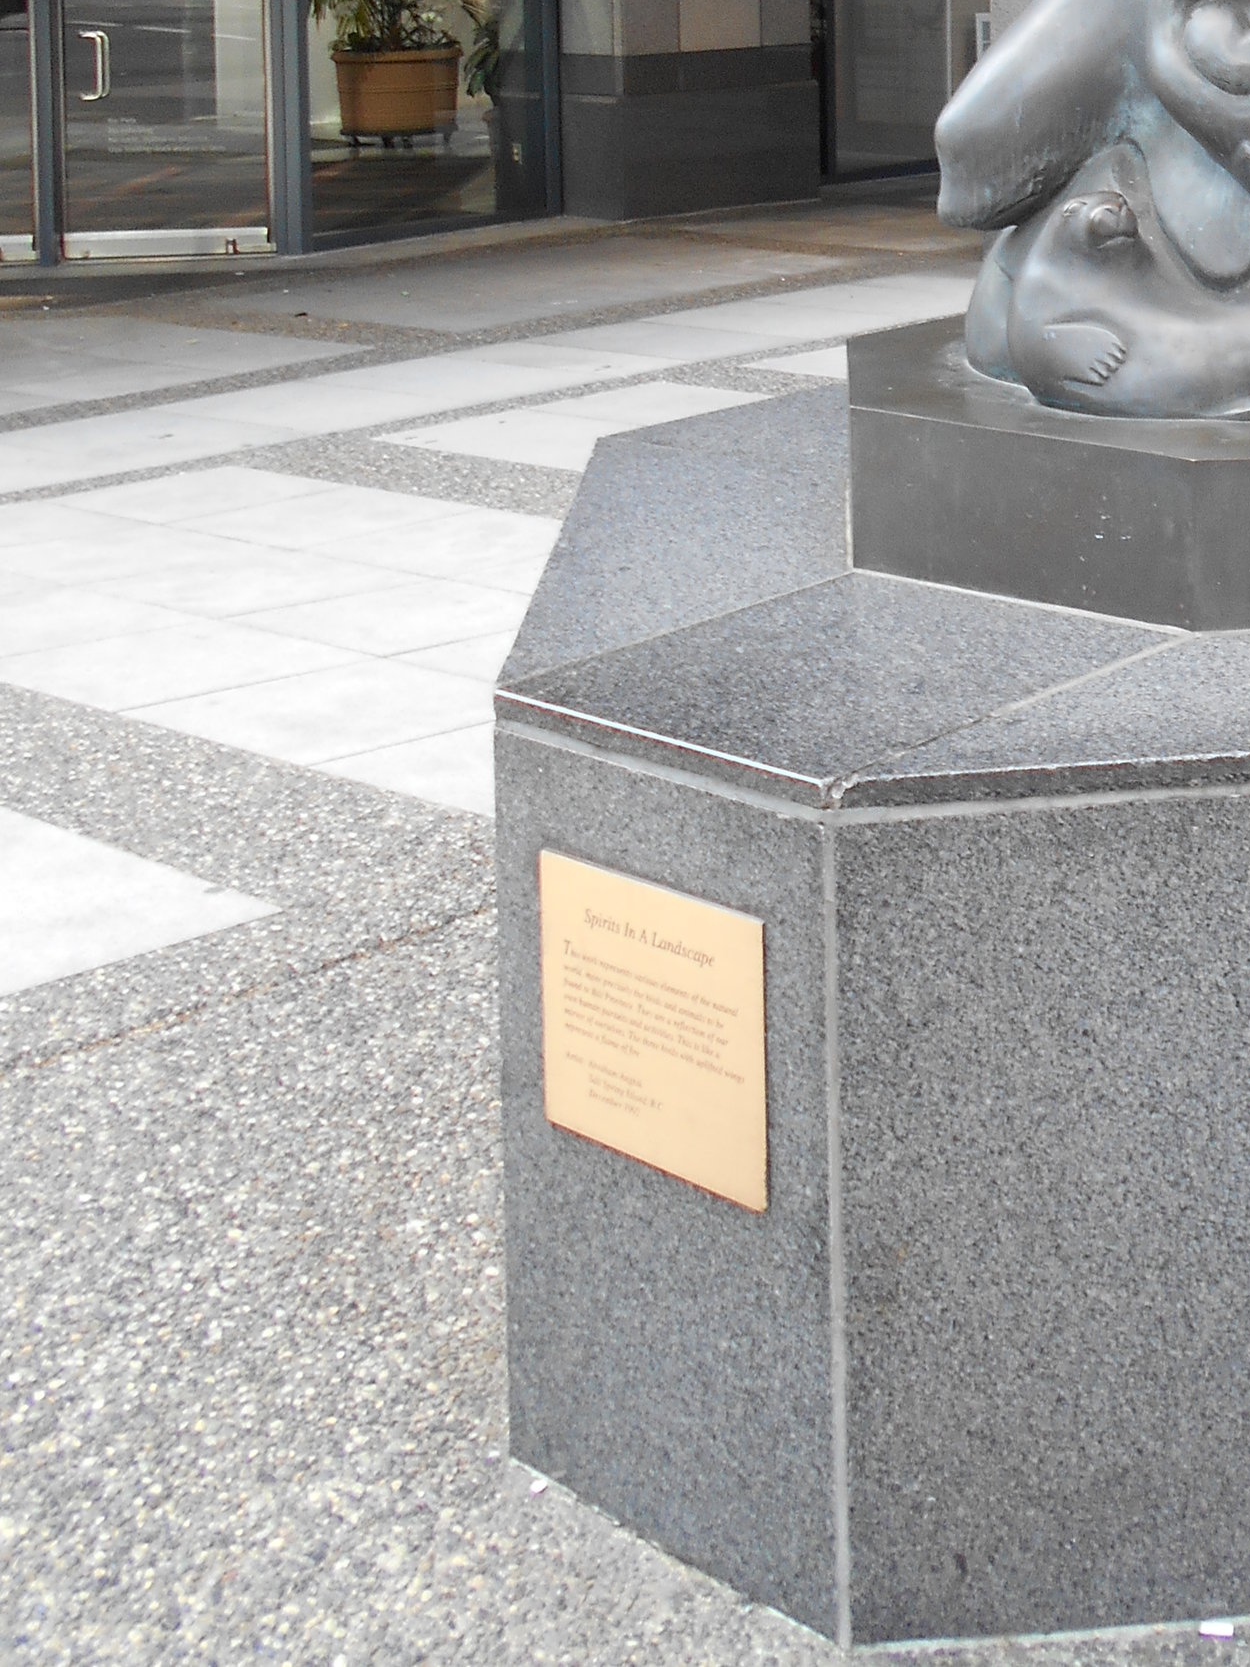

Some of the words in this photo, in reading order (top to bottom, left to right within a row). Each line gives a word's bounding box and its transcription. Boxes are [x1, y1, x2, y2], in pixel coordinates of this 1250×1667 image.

[583, 908, 621, 937] Spirits
[624, 921, 637, 938] In
[639, 928, 648, 944] A
[651, 931, 716, 968] Landscape
